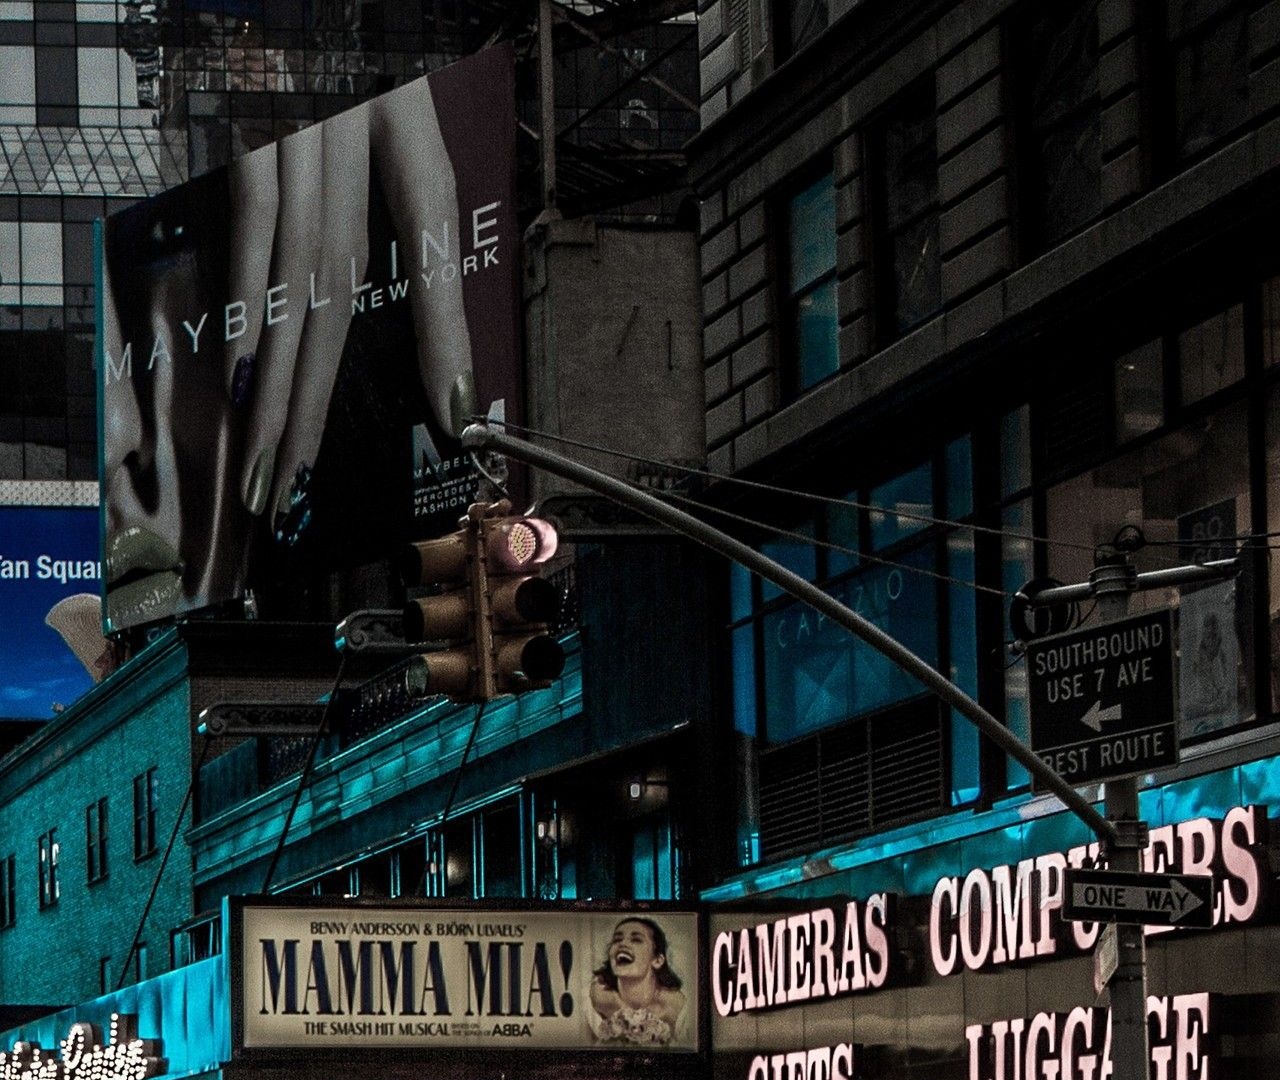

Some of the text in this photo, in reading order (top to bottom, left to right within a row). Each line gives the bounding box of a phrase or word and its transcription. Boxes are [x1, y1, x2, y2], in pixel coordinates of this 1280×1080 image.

[102, 200, 502, 387] MAYBELLINE
[351, 245, 500, 315] NEW YORK
[413, 455, 472, 479] MAYBEL
[414, 495, 467, 517] FASHION
[776, 568, 904, 650] CAPZIO
[1035, 623, 1164, 676] SOUTHBOUND
[1047, 657, 1153, 703] USE 7 AVE
[1100, 731, 1165, 768] ROUTE
[929, 804, 1259, 977] COMPERS
[1083, 886, 1190, 910] ONE WAY
[309, 921, 348, 935] BENNY
[351, 922, 420, 937] ANDERSSON
[423, 922, 431, 936] &
[435, 921, 474, 937] BJÖRN
[711, 892, 890, 1017] CAMERAS
[258, 938, 575, 1018] MAMMA MIA!
[304, 1021, 451, 1037] THE SMASH HIT MUSICAL
[491, 1023, 532, 1037] ABBA
